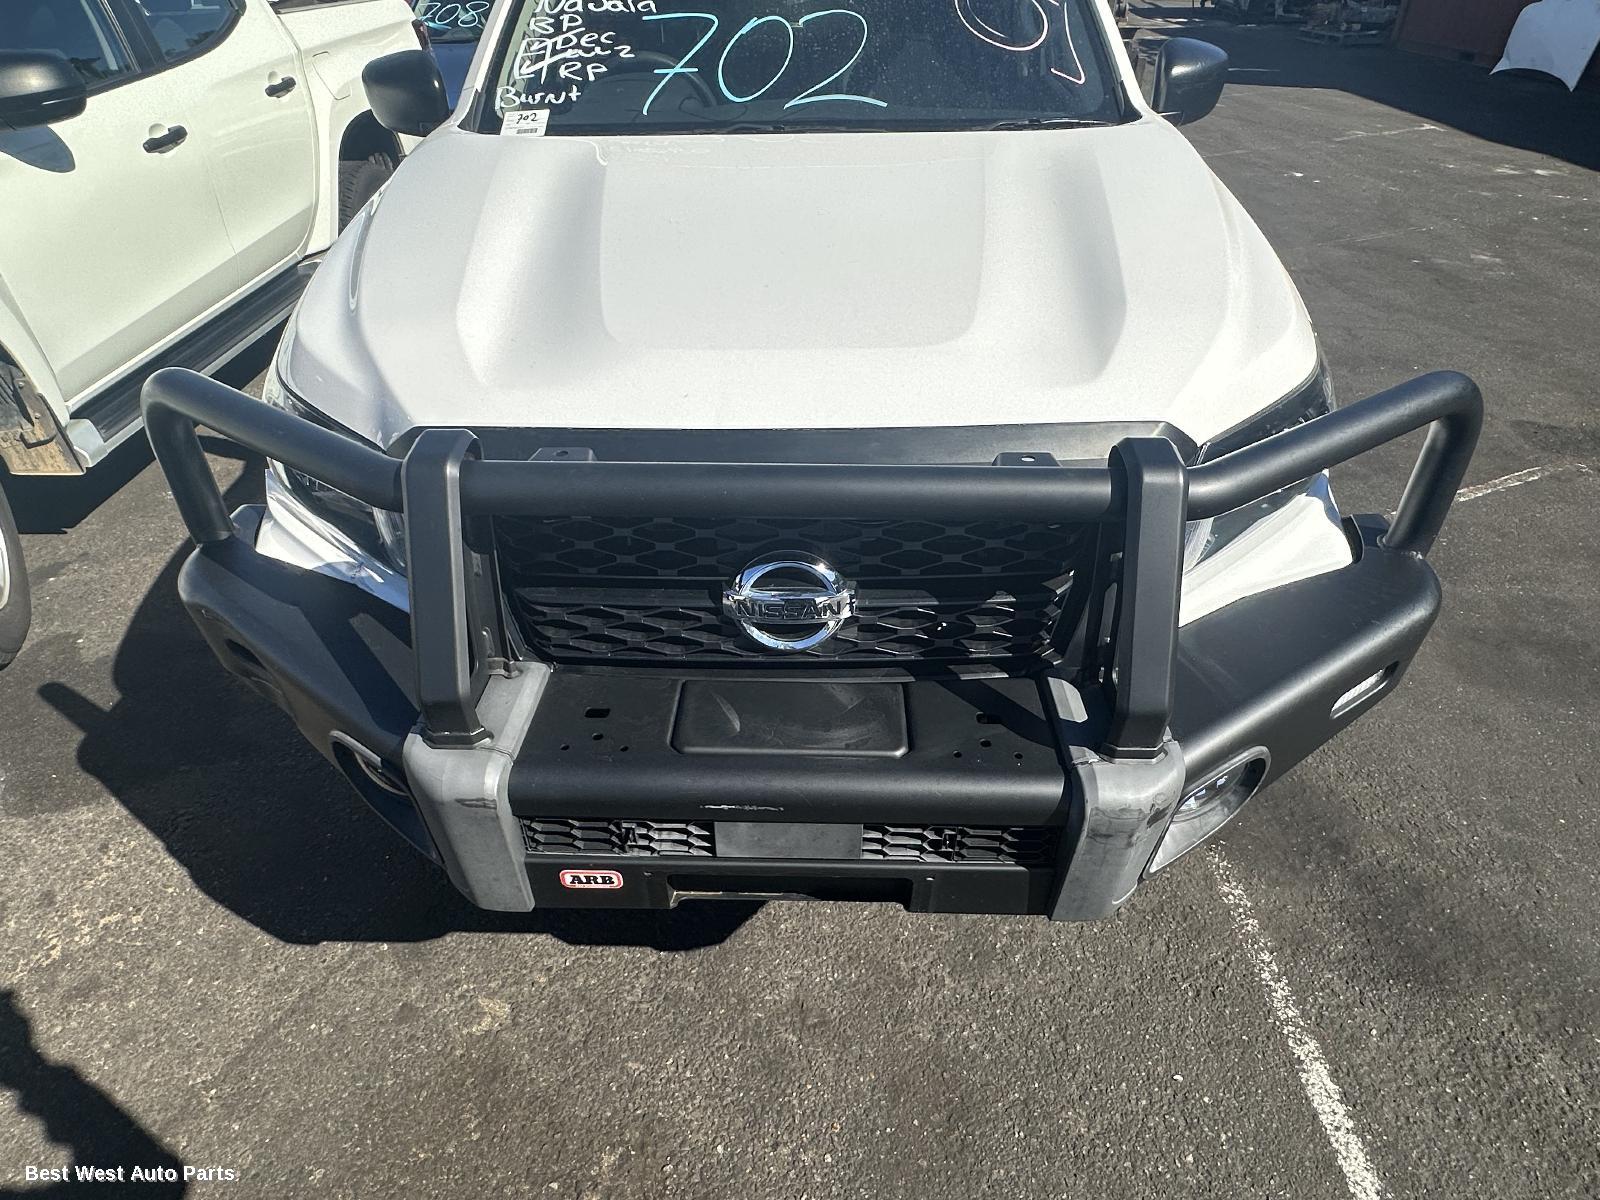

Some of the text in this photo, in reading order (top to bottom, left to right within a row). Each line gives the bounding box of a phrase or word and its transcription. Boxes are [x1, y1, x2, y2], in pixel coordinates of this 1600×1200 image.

[419, 1, 490, 27] 708
[642, 9, 888, 115] 702
[495, 85, 583, 109] Burnt
[515, 112, 538, 125] 702
[736, 598, 842, 620] NISSAN
[569, 874, 615, 885] ARB
